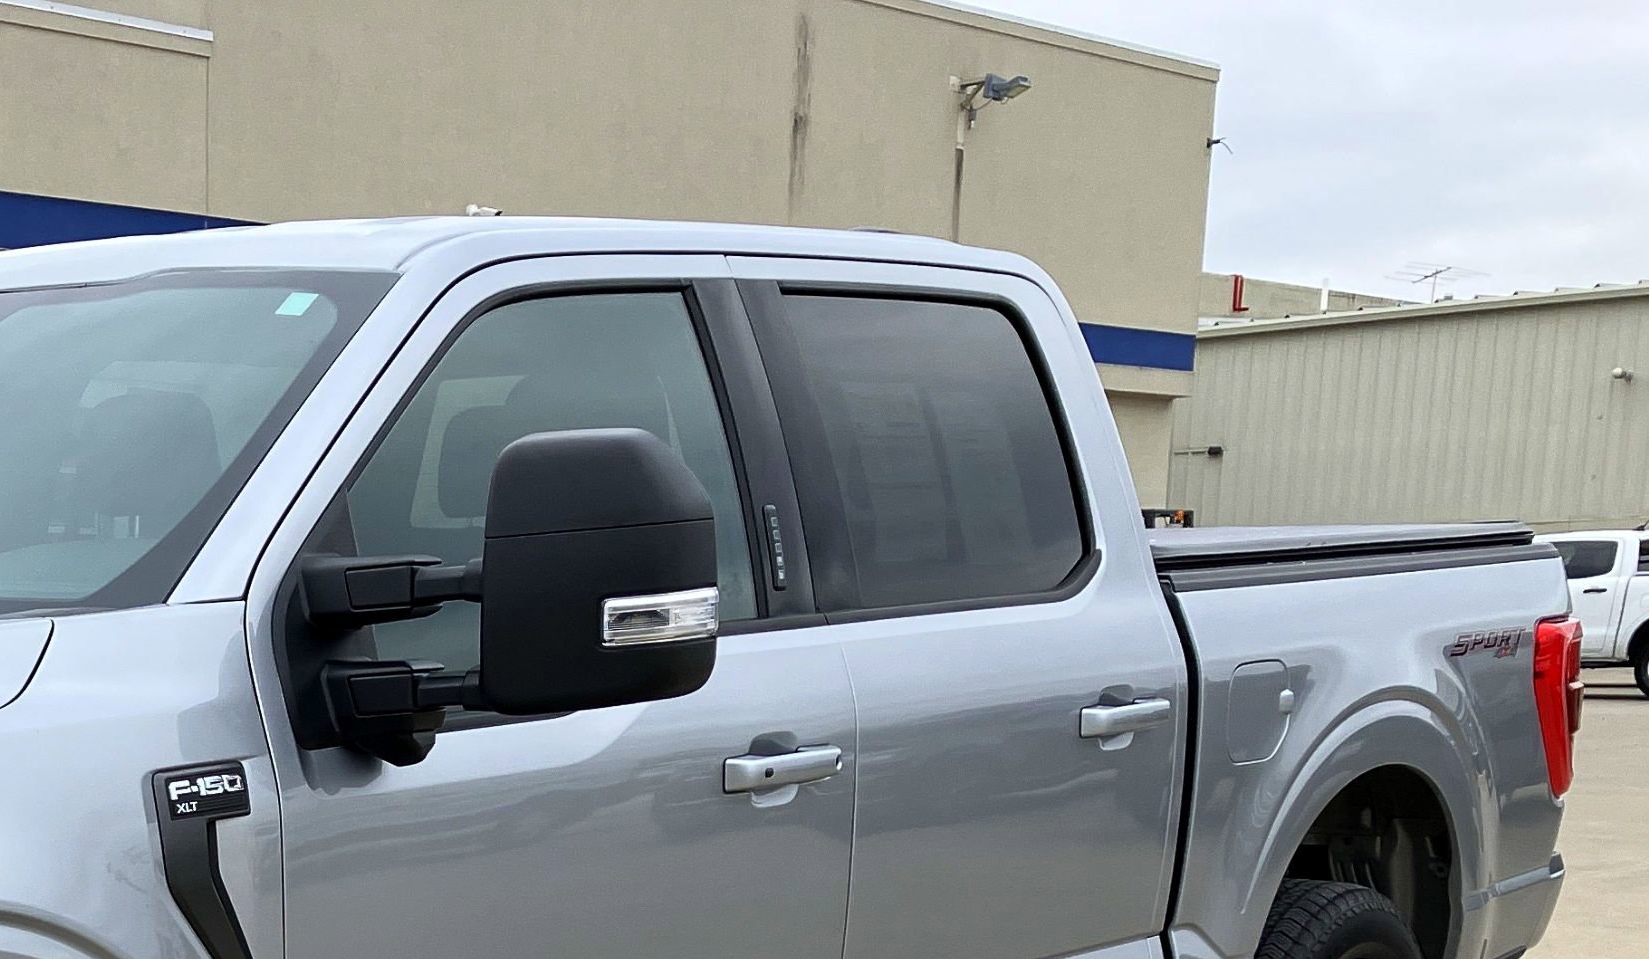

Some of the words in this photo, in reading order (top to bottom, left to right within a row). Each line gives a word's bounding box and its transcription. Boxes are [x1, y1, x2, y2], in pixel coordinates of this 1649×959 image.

[1450, 625, 1527, 657] SPORT
[168, 774, 245, 801] F-150
[175, 801, 199, 814] XLT
